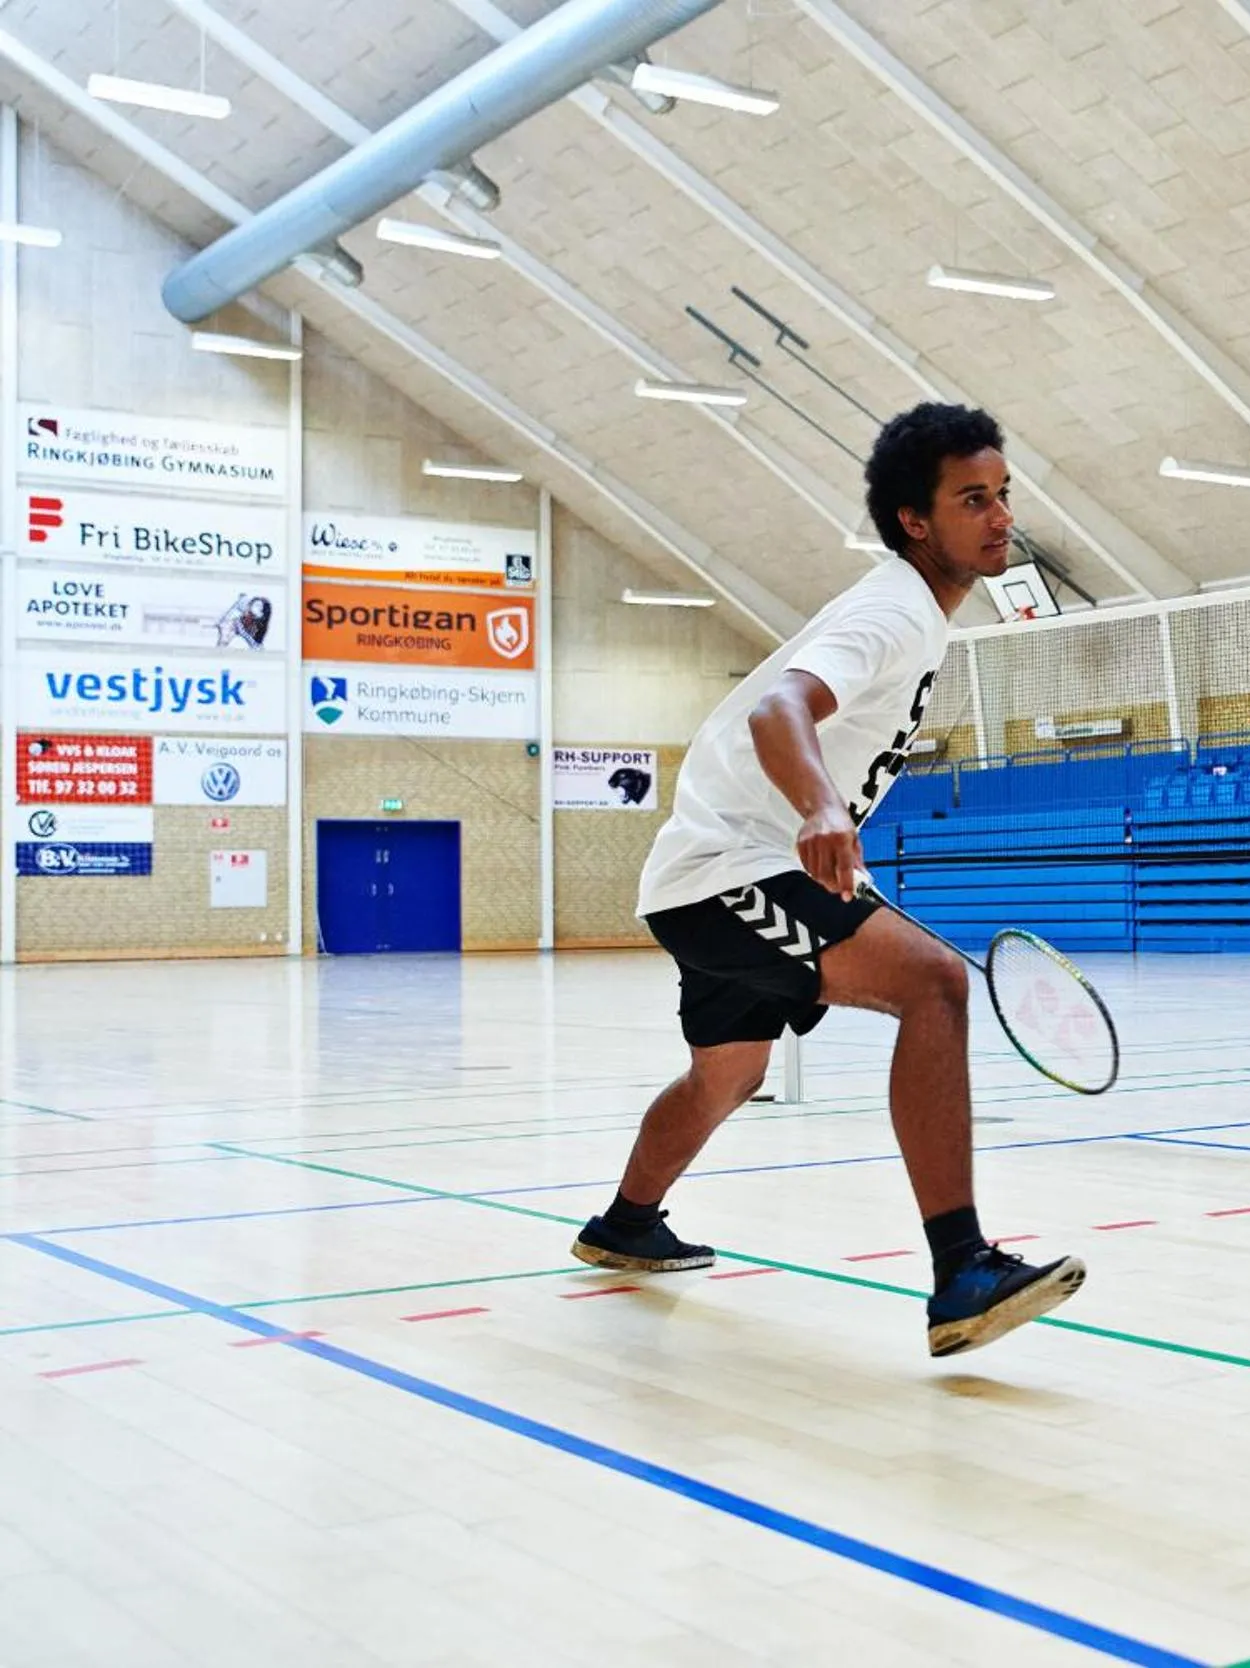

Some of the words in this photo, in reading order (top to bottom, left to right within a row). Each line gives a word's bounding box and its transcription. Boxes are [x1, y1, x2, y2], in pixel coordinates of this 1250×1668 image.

[161, 455, 275, 482] GYMNASIUM
[79, 522, 121, 549] Fri
[134, 527, 273, 564] BikeShop
[27, 598, 129, 619] APOTEKET
[305, 599, 477, 631] Sportigan
[46, 667, 246, 713] vestjysk
[356, 681, 526, 707] Ringkøbing-Skjern
[357, 706, 451, 725] Kommune
[554, 750, 652, 765] RH-SUPPORT
